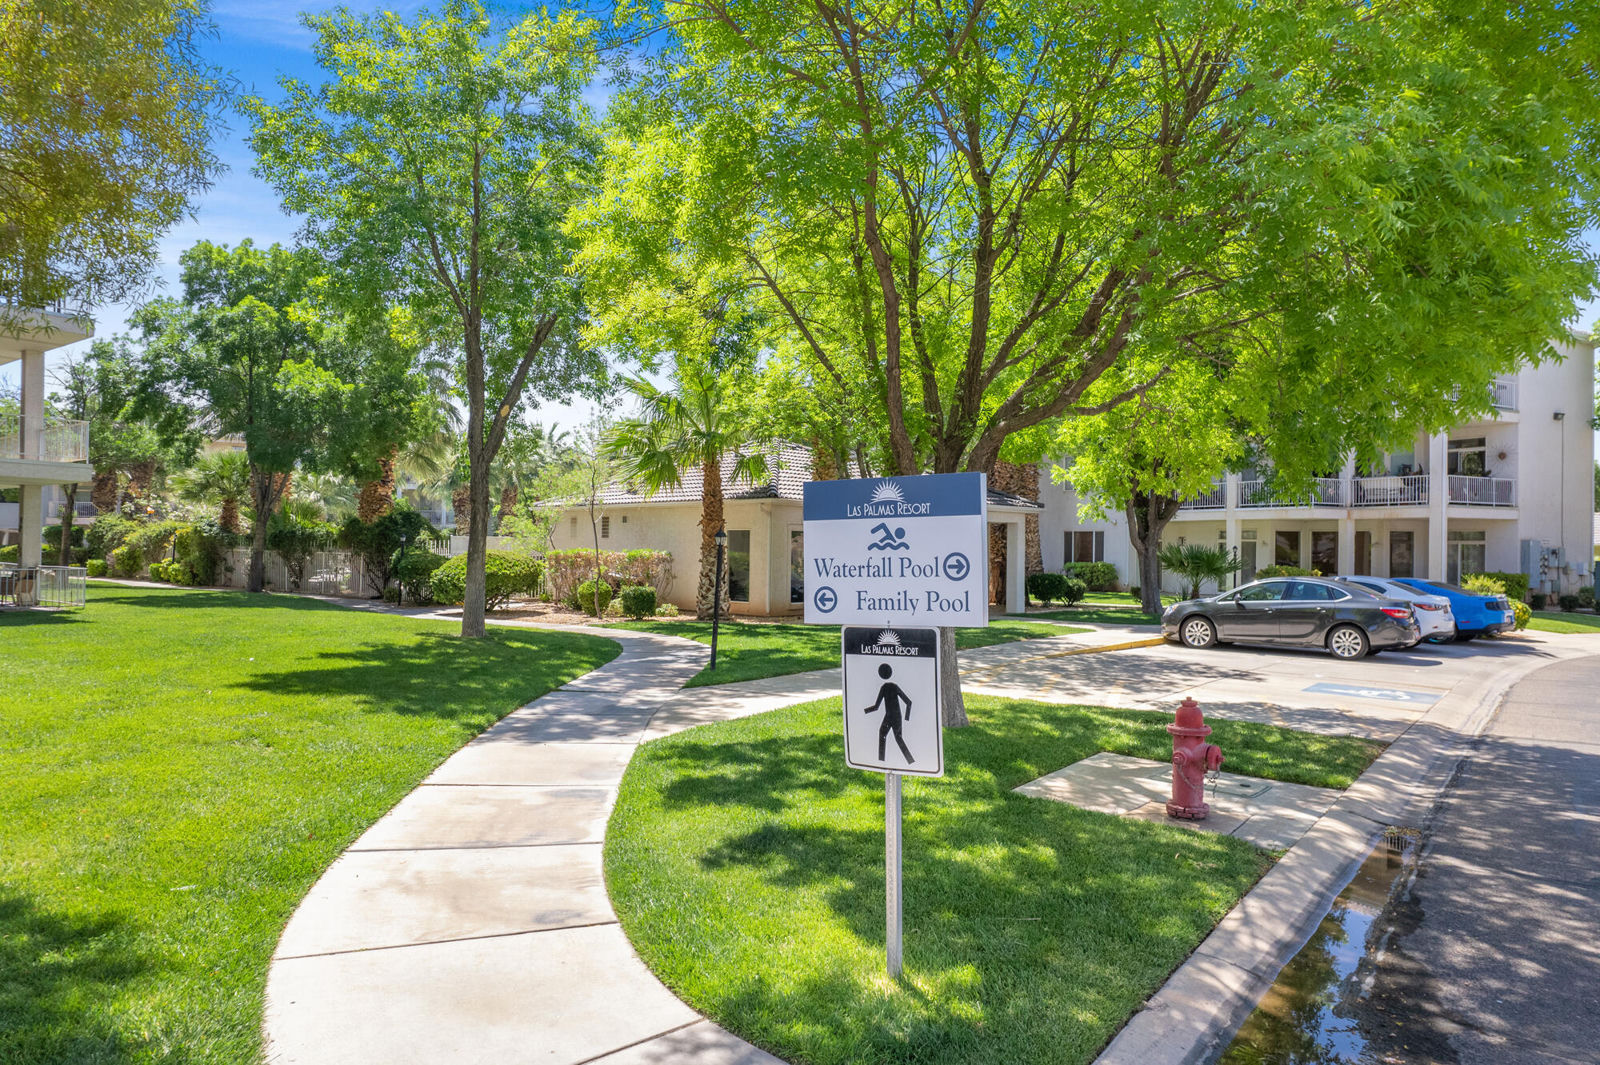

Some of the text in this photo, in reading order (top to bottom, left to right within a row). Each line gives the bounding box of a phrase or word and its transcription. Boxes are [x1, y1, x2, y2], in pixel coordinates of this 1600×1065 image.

[814, 556, 940, 578] Waterfall Pool
[856, 590, 970, 616] Family Pool
